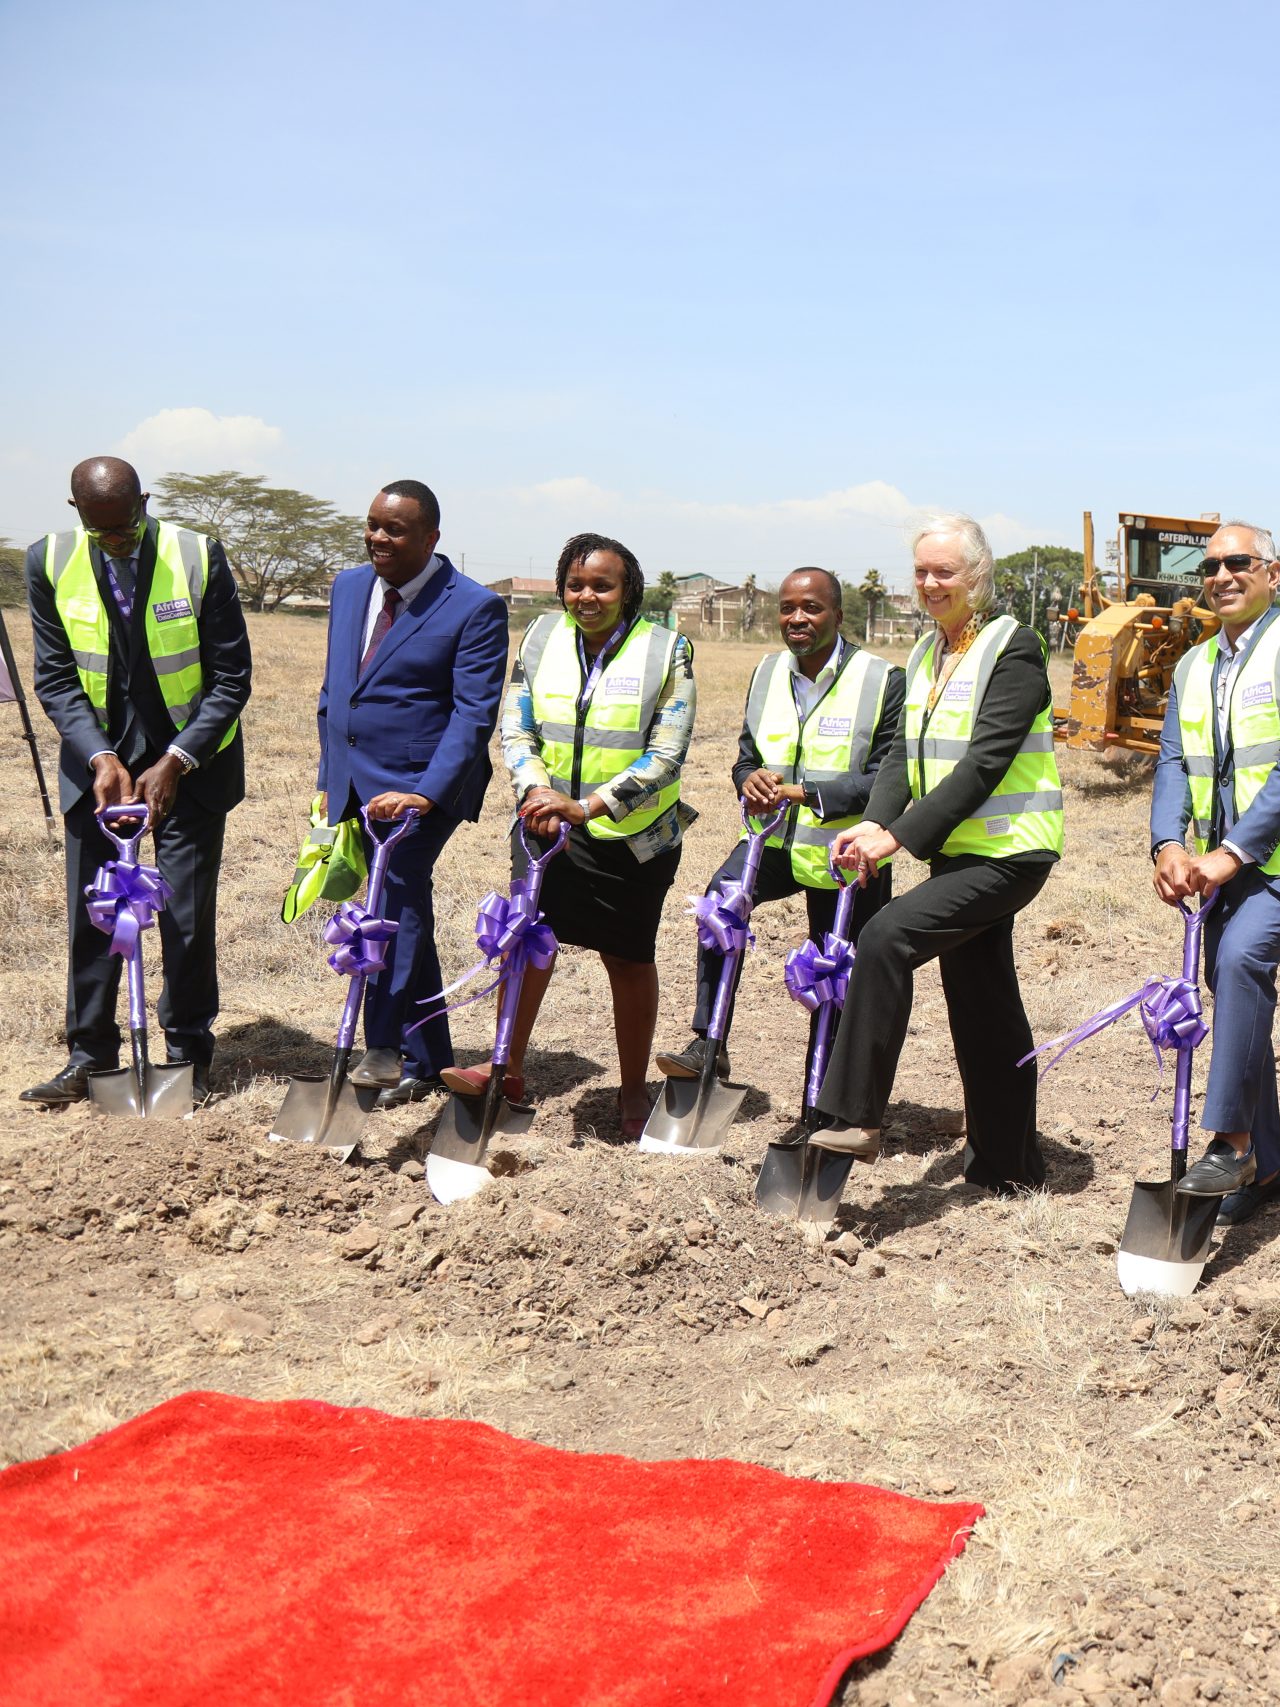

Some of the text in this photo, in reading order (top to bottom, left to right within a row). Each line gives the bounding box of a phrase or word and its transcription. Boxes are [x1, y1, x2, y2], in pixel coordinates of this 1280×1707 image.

[156, 599, 188, 613] Africa
[608, 678, 638, 687] Africa
[1243, 684, 1271, 699] Africa
[821, 717, 850, 728] Africa
